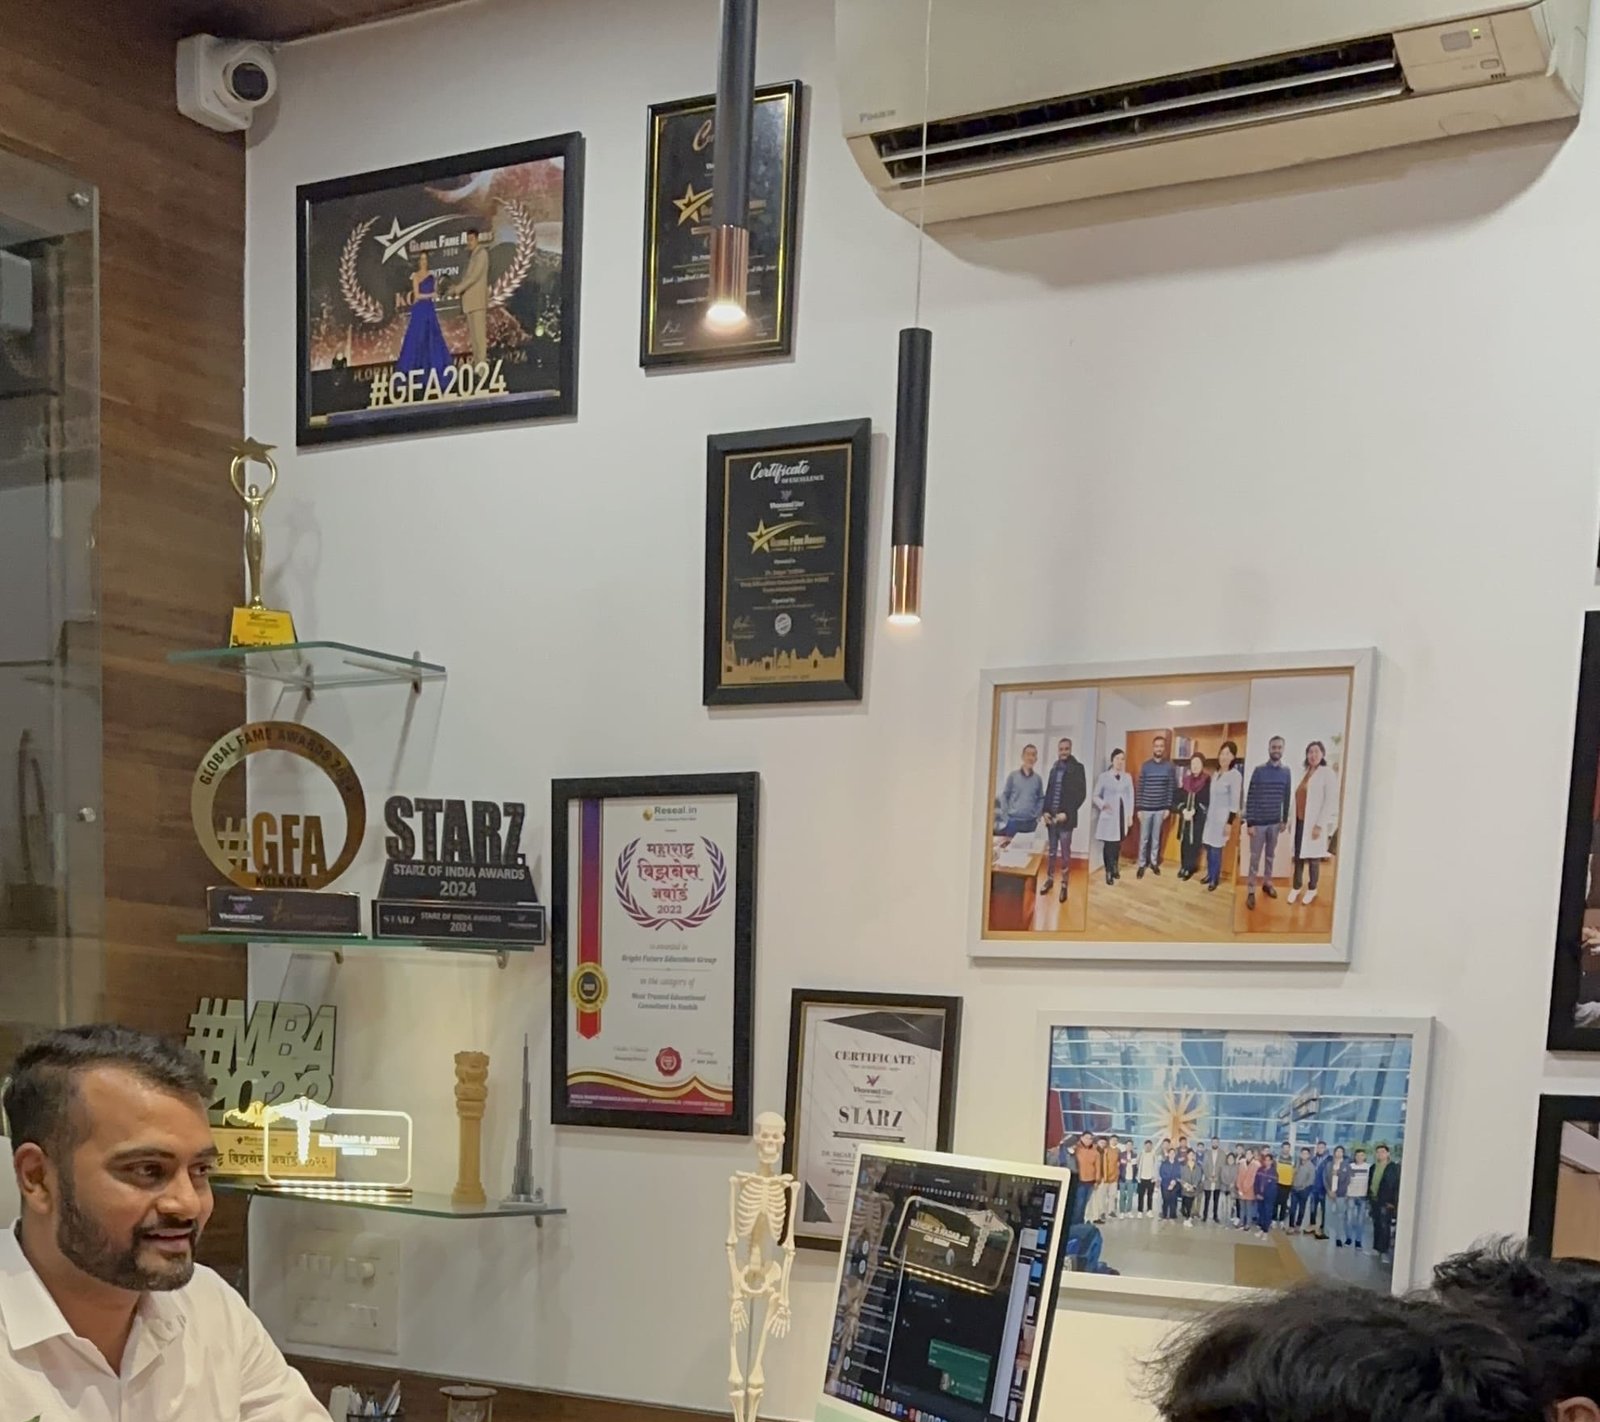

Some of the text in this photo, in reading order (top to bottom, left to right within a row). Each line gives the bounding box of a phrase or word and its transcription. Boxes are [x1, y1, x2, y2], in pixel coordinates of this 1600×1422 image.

[370, 360, 507, 408] #GFA2024
[750, 460, 810, 484] Certificate
[199, 741, 237, 786] GLOBAL
[235, 727, 273, 750] FAME
[277, 728, 333, 762] AWARDS
[216, 811, 328, 876] #GFA
[255, 874, 310, 888] KOLKATA
[393, 863, 525, 880] STARZ OF INDIA AWARDS
[439, 880, 477, 898] 2024
[450, 922, 473, 933] 2024
[834, 1050, 916, 1066] CERTIFICATE
[838, 1105, 903, 1129] STARZ
